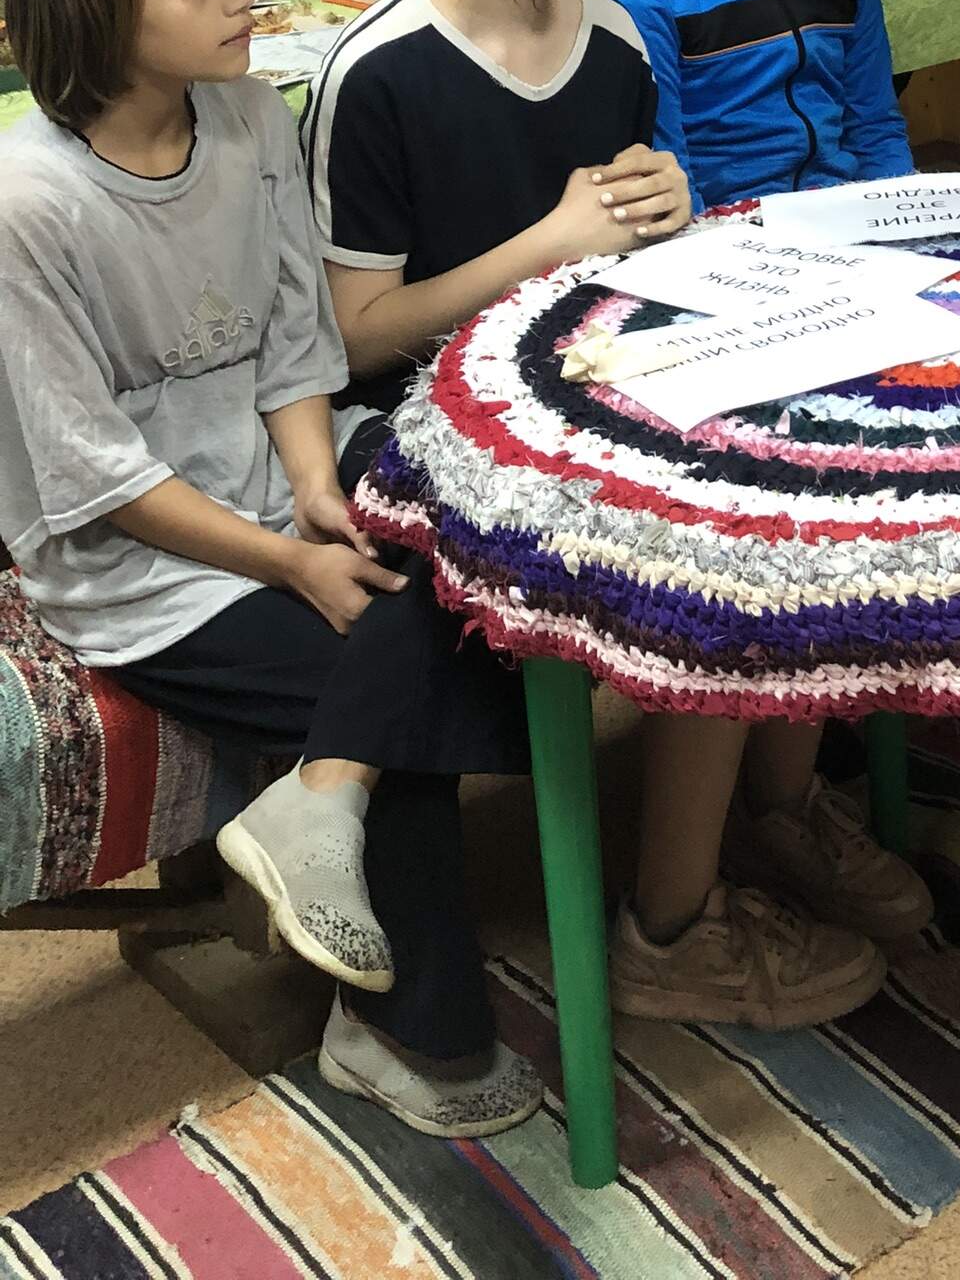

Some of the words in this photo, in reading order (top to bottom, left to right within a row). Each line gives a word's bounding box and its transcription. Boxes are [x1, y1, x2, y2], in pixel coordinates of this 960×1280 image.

[896, 200, 946, 211] ЭТО
[732, 239, 866, 267] ЗДОРОВЬЕ
[748, 262, 800, 276] ЭТО
[699, 271, 790, 296] ЖИЗНЬ
[753, 295, 851, 328] МОДНО
[735, 308, 875, 350] СВОБОДНО
